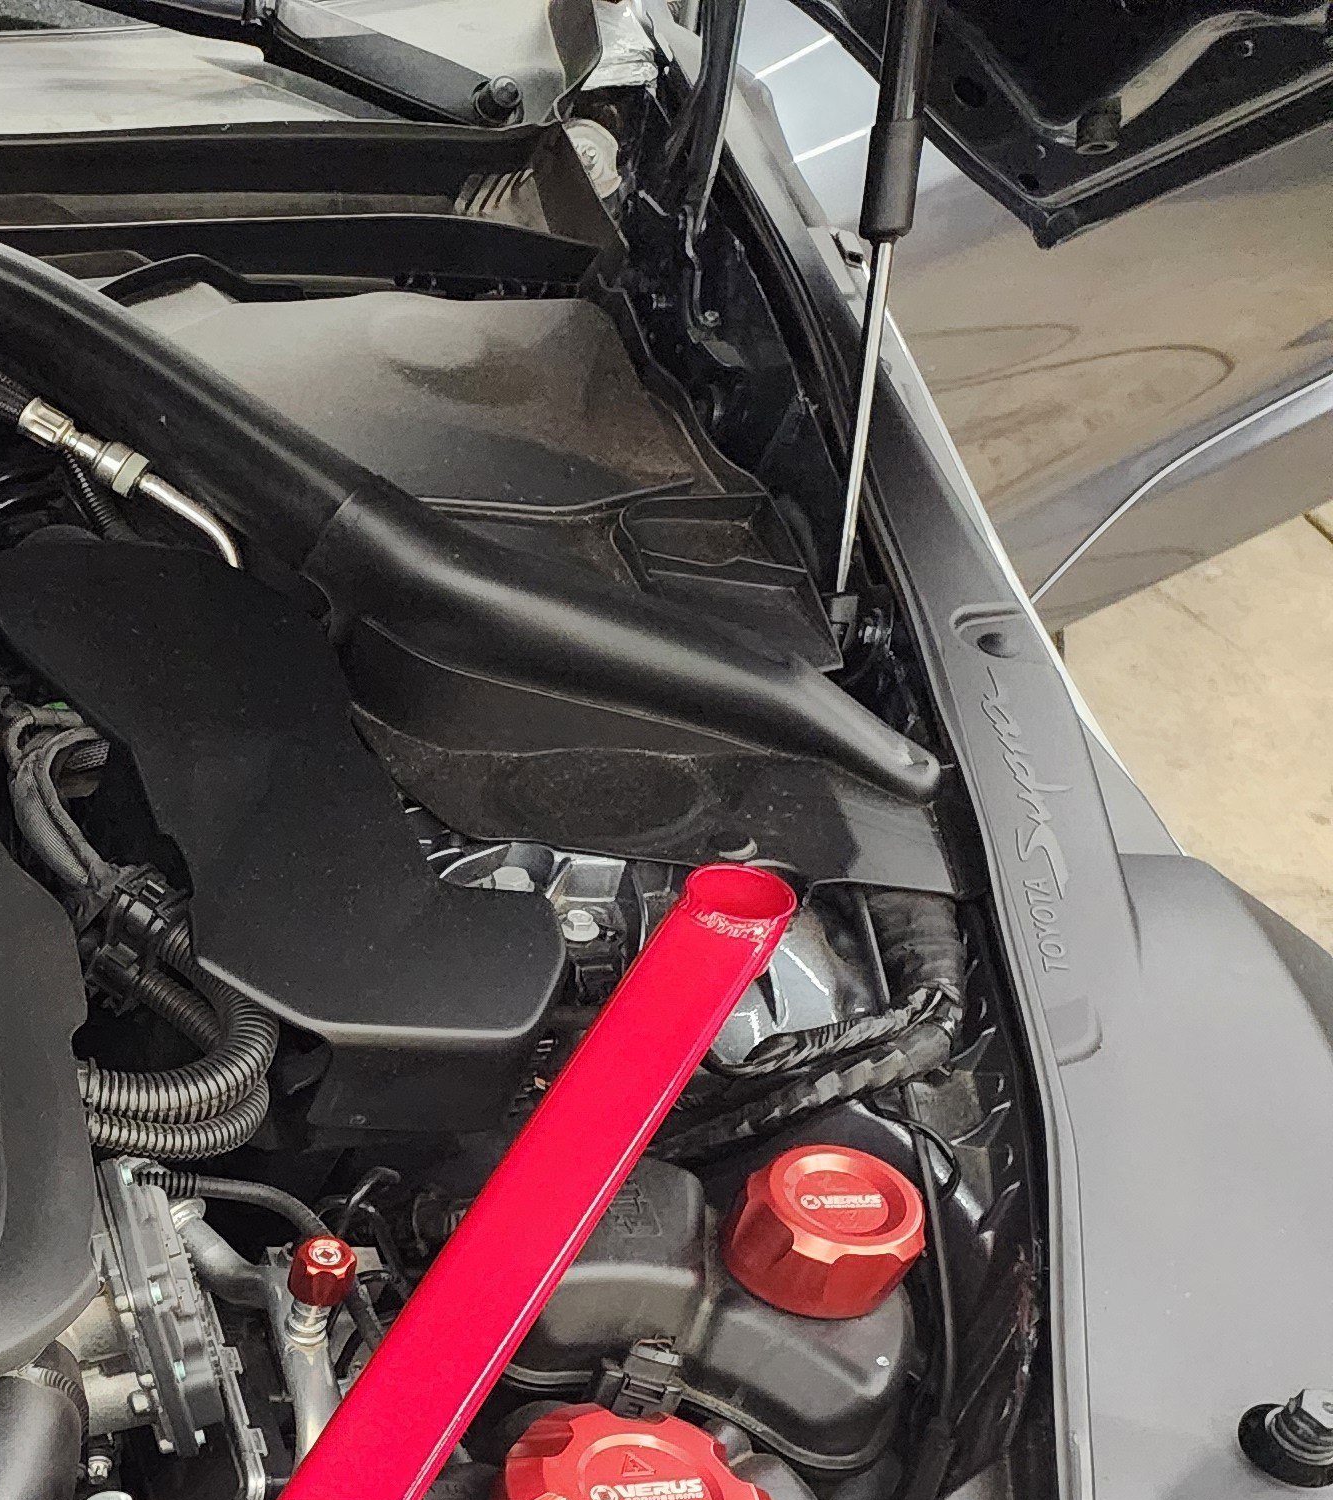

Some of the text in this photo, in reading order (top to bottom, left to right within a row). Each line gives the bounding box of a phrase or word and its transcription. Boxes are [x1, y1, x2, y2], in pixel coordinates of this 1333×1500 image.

[981, 664, 1073, 974] TOYOTA Supra
[818, 1194, 883, 1205] VERUS
[614, 1478, 703, 1498] VERUS
